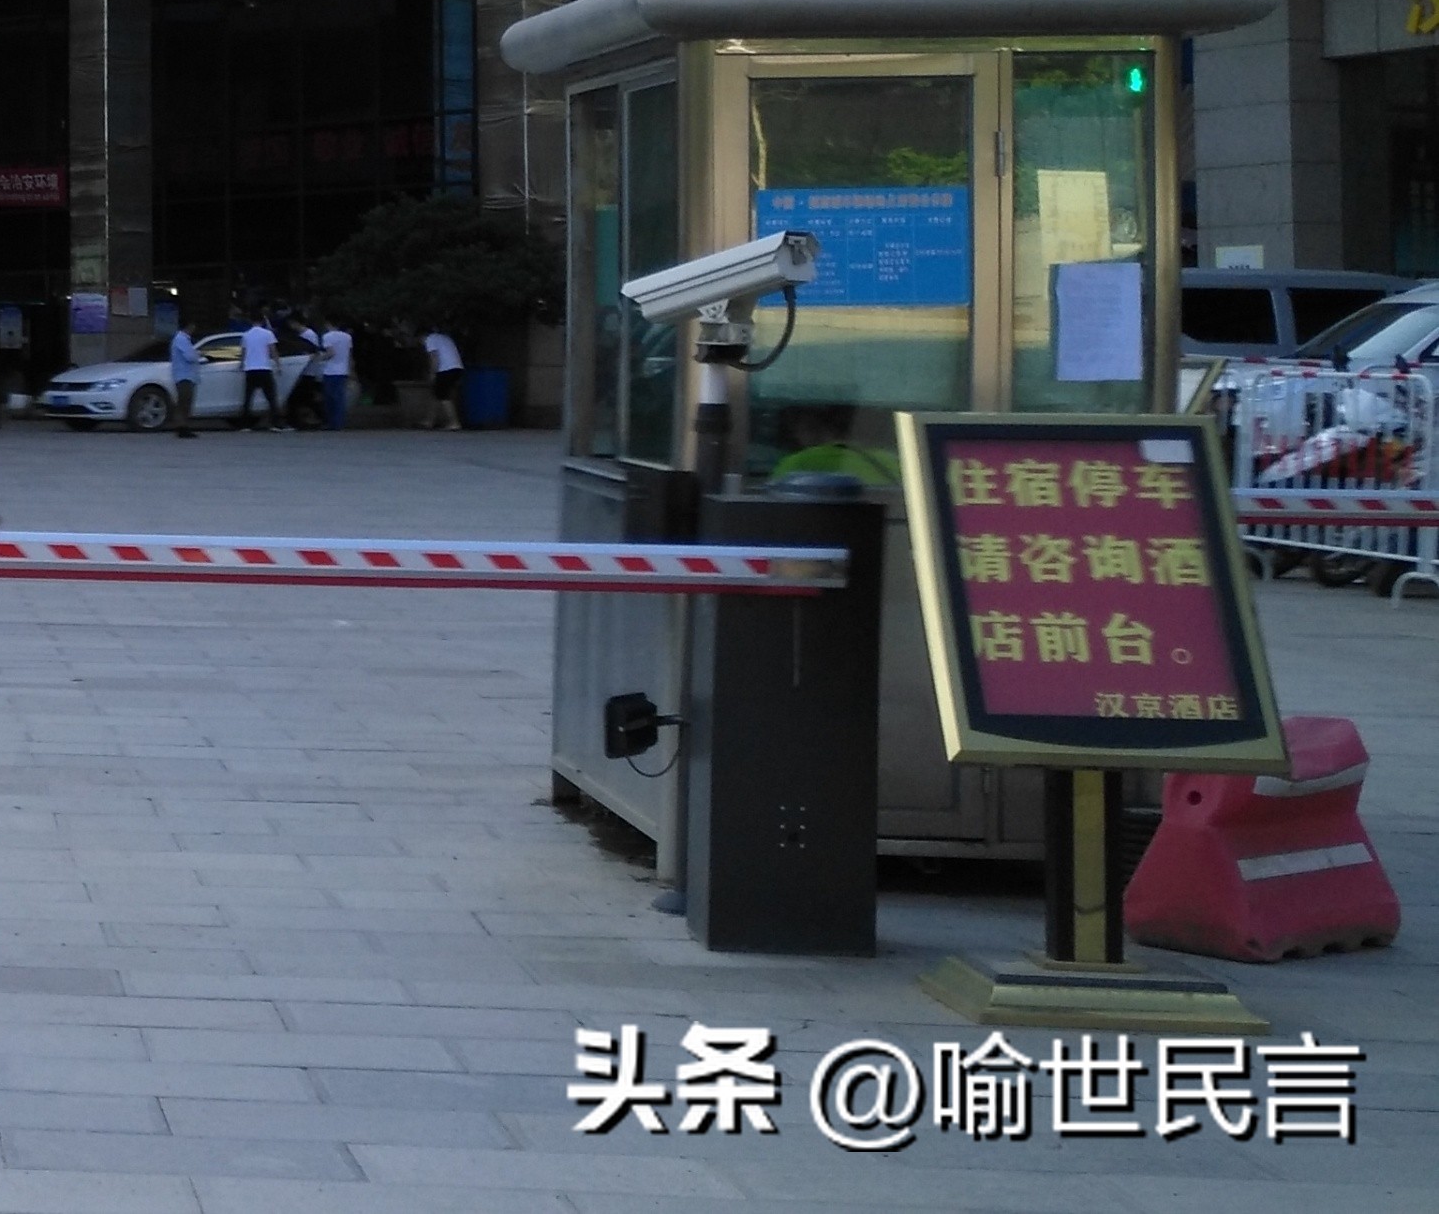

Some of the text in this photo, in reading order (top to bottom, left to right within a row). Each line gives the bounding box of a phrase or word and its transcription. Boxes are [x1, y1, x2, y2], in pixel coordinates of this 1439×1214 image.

[946, 458, 1195, 509] 住宿停车
[957, 533, 1211, 586] 请咨询酒
[1094, 692, 1240, 721] 汉京酒店
